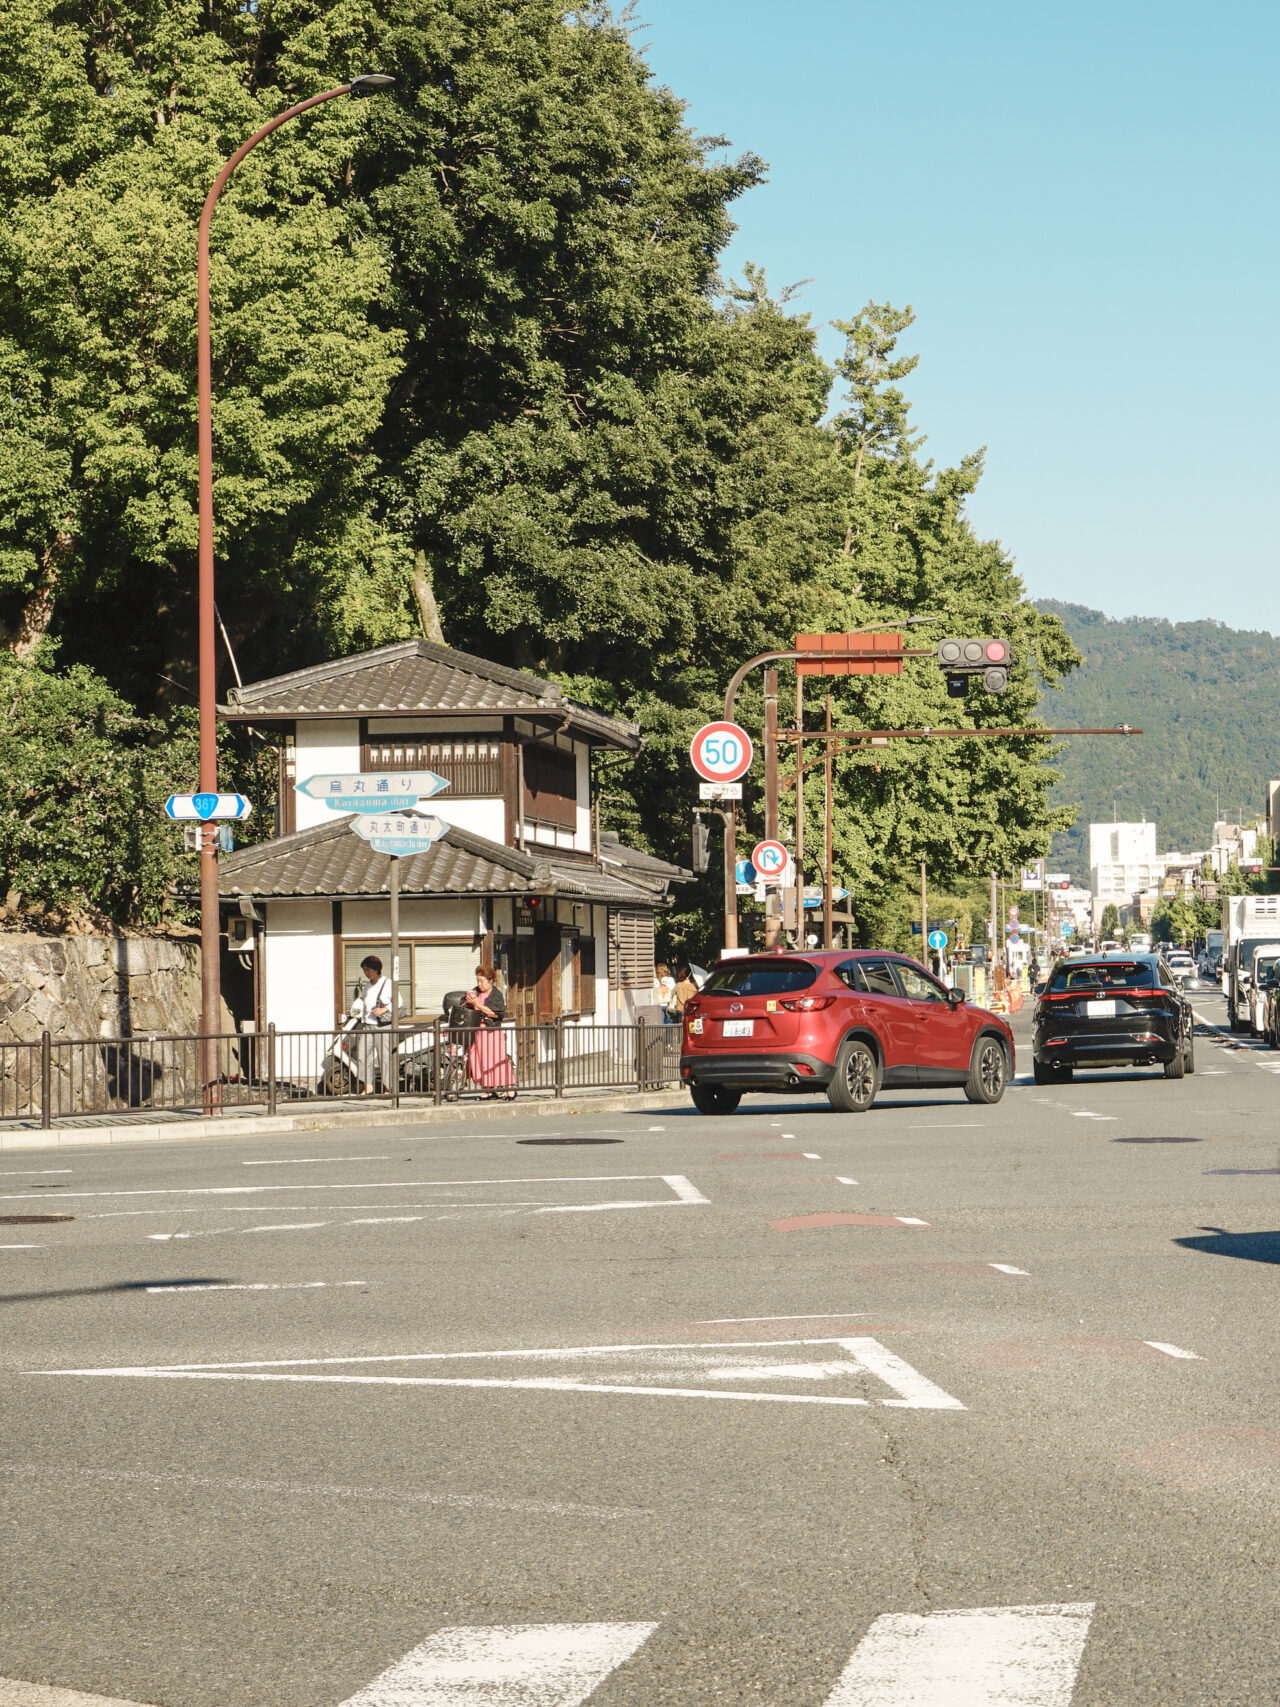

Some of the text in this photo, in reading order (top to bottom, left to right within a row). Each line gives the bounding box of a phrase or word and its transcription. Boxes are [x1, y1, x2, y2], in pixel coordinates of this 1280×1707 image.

[706, 740, 737, 765] 50
[329, 778, 412, 794] 烏丸通り
[195, 798, 216, 810] 367
[333, 797, 387, 808] Karasuma
[369, 820, 431, 834] 丸太町通り
